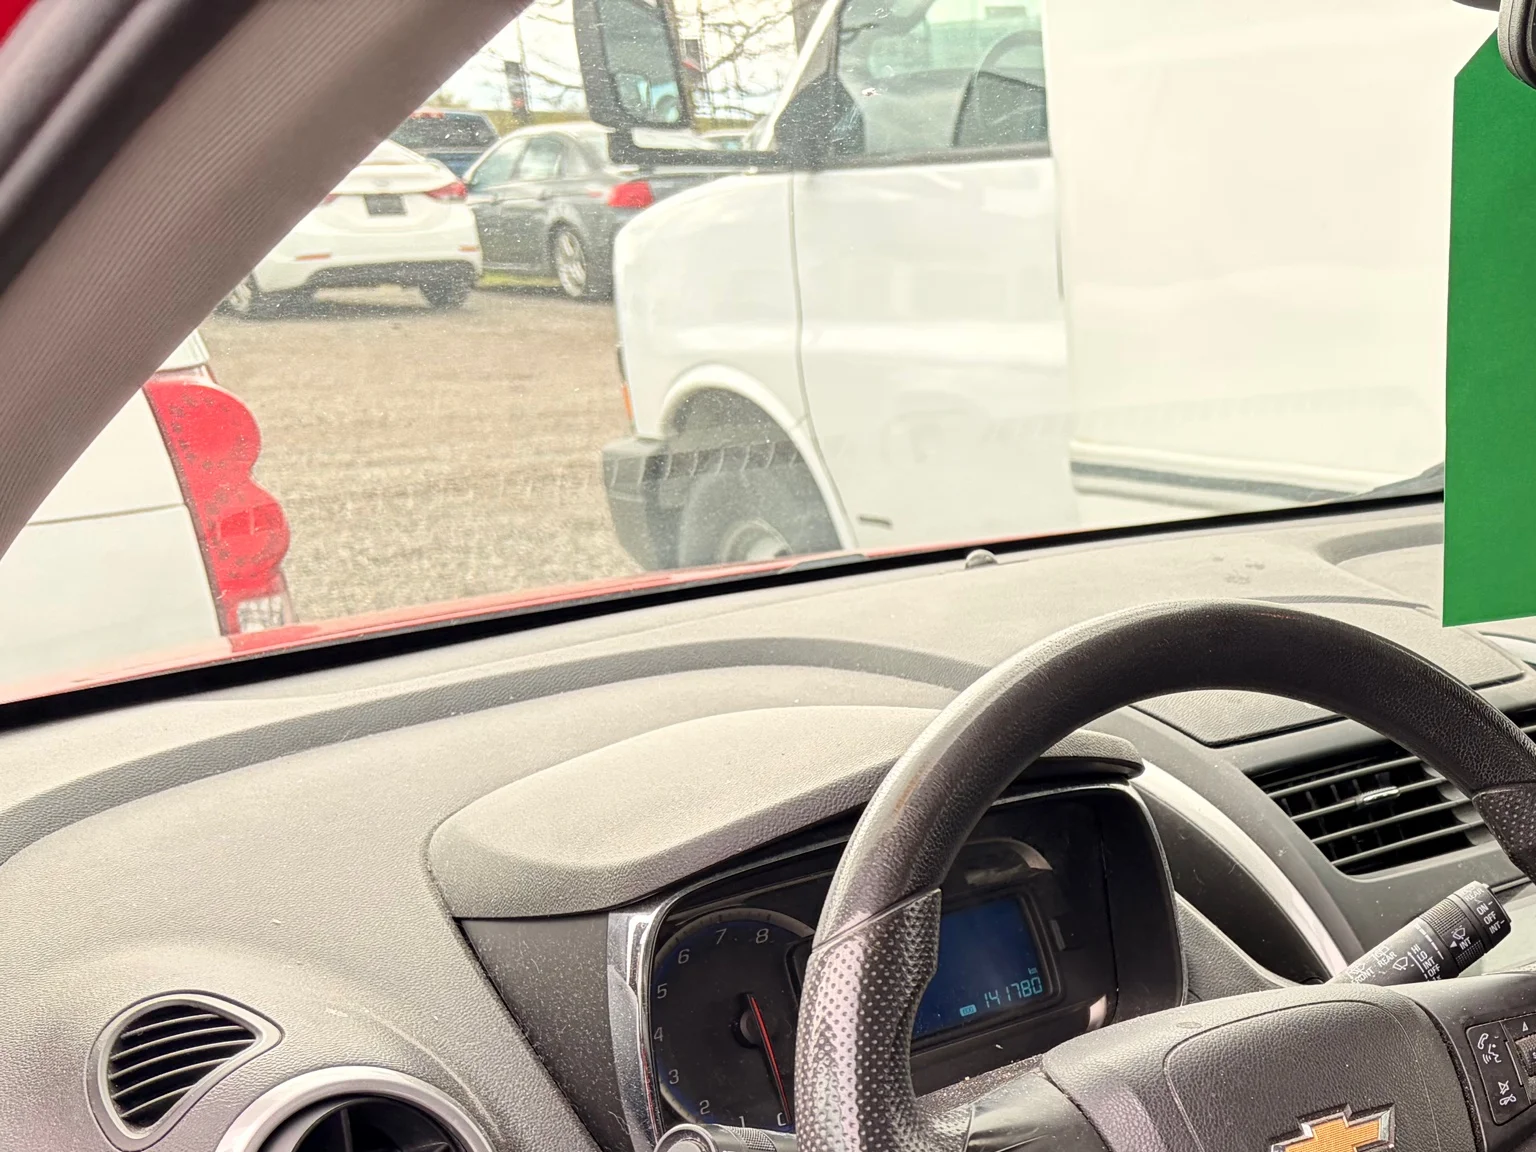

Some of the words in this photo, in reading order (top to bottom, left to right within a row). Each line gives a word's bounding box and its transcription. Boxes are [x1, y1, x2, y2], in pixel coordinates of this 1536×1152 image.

[1476, 903, 1489, 915] ON
[1483, 911, 1496, 925] OFF
[1489, 921, 1501, 934] INT
[716, 928, 727, 945] 7
[755, 928, 769, 944] 8
[1459, 936, 1471, 950] INT
[677, 949, 690, 964] 6
[1411, 944, 1421, 955] HI
[1416, 950, 1428, 962] LO
[1377, 951, 1398, 968] REAR
[1422, 957, 1435, 970] INT
[1427, 963, 1441, 977] OFF
[656, 983, 668, 999] 5
[984, 976, 1043, 1009] 141780
[653, 1026, 664, 1042] 4
[668, 1068, 679, 1085] 3
[699, 1099, 710, 1115] 2
